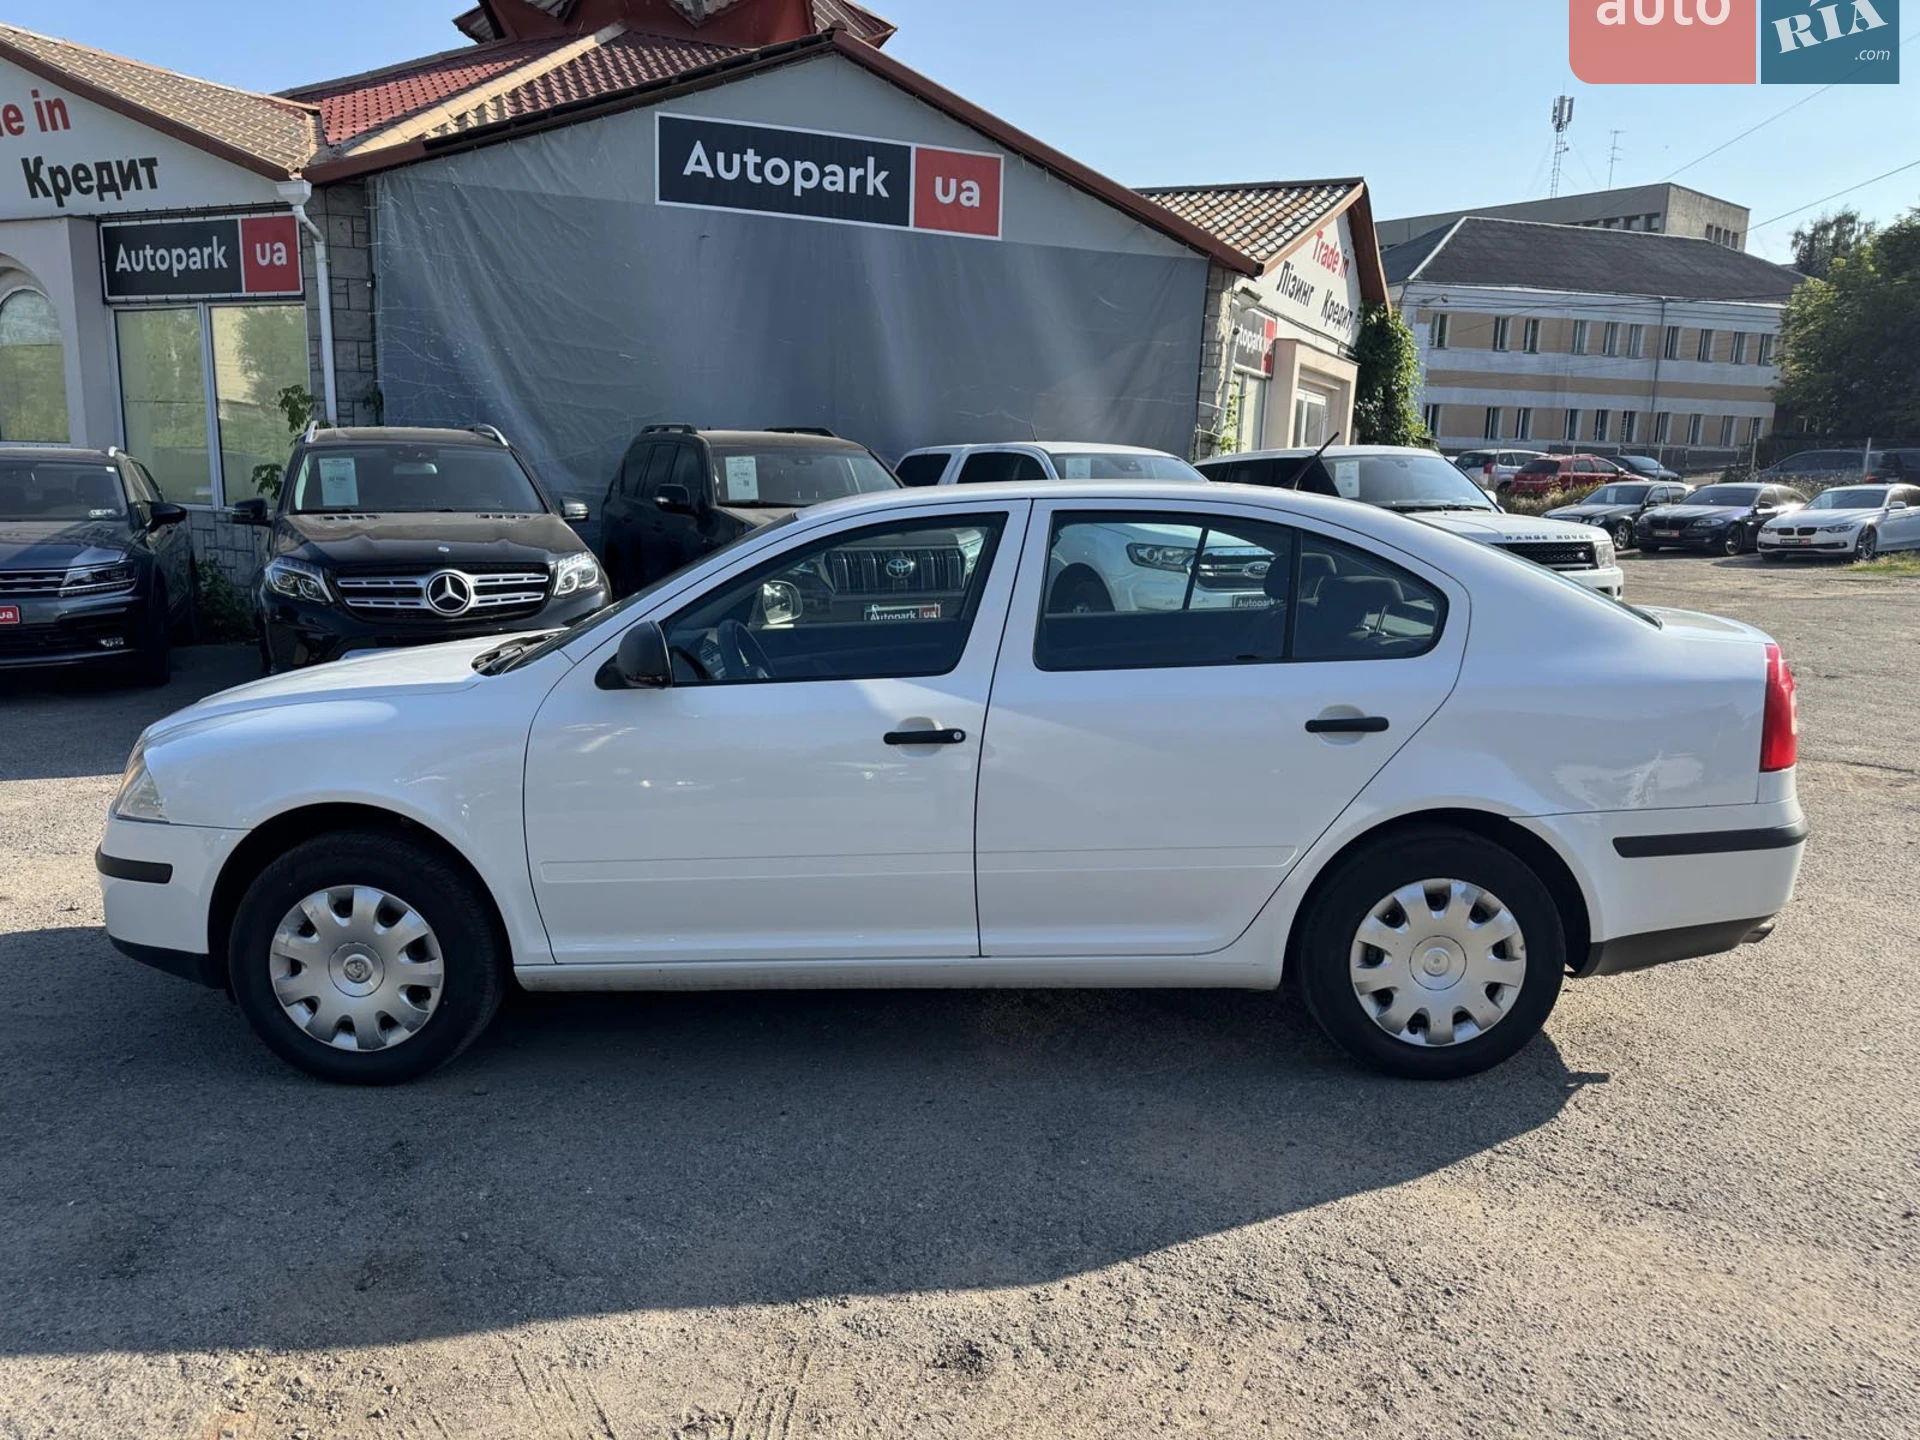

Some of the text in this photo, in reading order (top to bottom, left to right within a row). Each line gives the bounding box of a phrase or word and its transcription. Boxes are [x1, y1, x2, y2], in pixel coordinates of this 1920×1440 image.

[31, 89, 71, 133] in
[21, 155, 158, 208] Кредит
[683, 140, 980, 208] Autopark ua
[115, 235, 287, 277] Autopark ua
[1312, 230, 1340, 274] Trade
